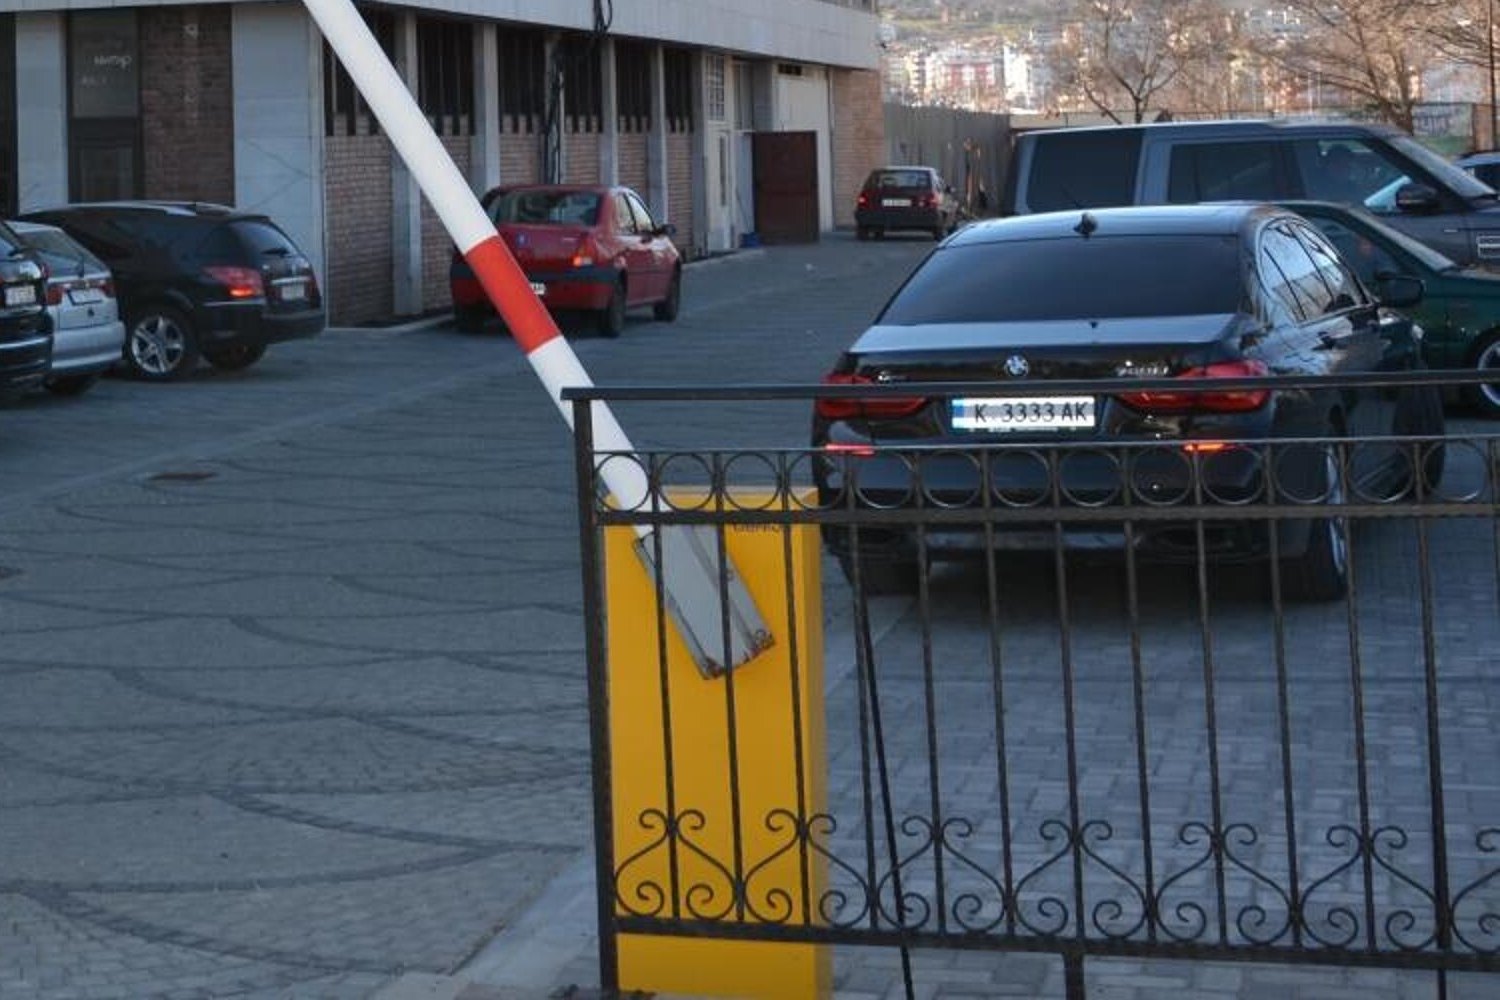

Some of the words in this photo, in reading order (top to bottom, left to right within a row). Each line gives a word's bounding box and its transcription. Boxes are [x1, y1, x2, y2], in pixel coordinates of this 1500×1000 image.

[974, 403, 988, 423] K
[1001, 403, 1055, 423] 3333
[1061, 401, 1089, 422] AK
